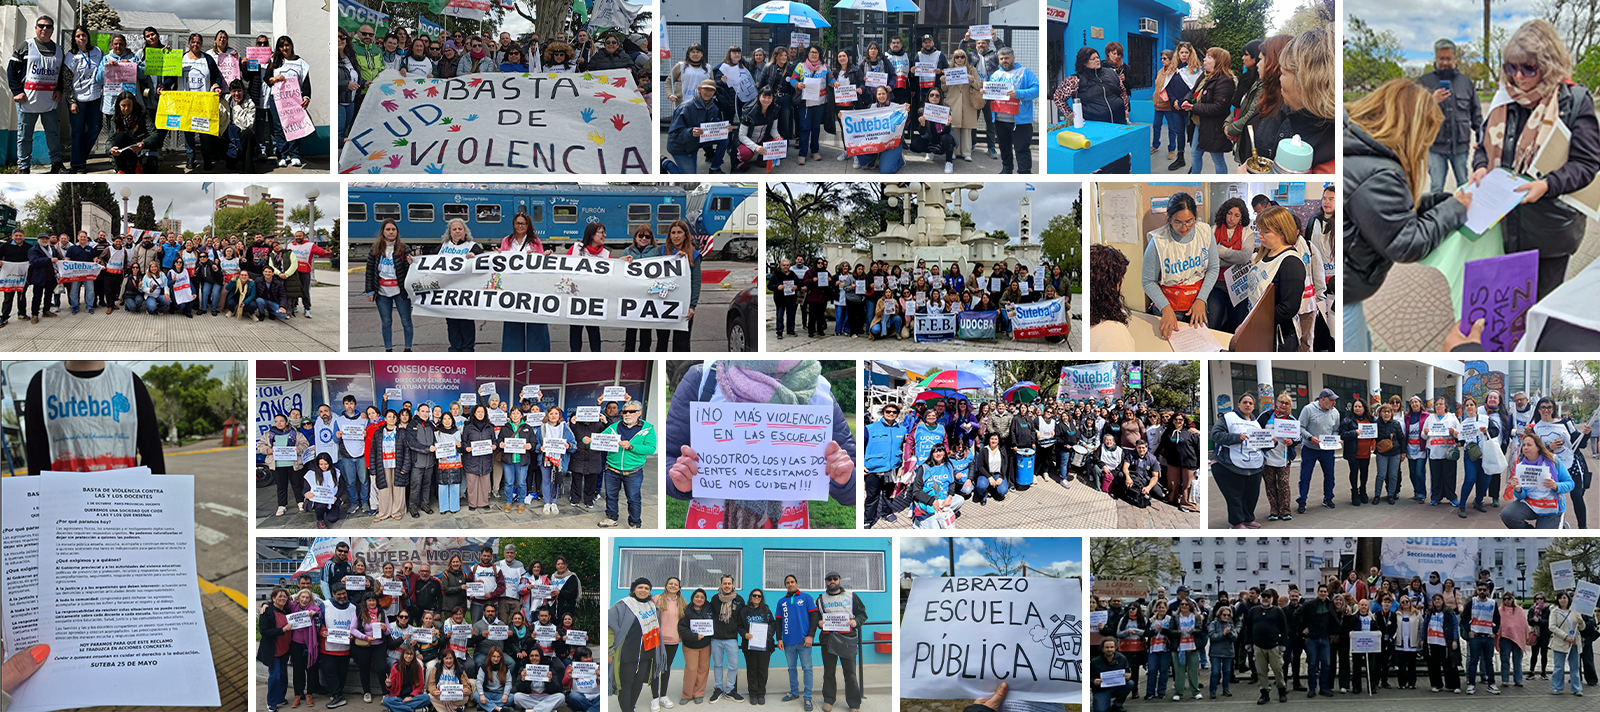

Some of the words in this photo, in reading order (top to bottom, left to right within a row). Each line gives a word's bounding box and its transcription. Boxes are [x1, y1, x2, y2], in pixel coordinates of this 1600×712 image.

[338, 4, 384, 27] DOCBA
[443, 77, 579, 100] BASTA
[498, 109, 546, 127] DE
[845, 117, 889, 134] Suteba
[410, 137, 649, 174] VIOLENCIA
[62, 262, 91, 270] Suteba
[417, 256, 464, 273] LAS
[474, 254, 610, 275] ESCUELAS
[628, 260, 682, 279] SON
[1164, 254, 1201, 275] Suteba
[416, 290, 560, 313] TERRITORIO
[571, 298, 604, 316] DE
[620, 300, 680, 320] PAZ
[1016, 306, 1050, 320] Suteba
[918, 318, 954, 331] F.E.B.
[960, 318, 994, 329] UDOCBA
[387, 365, 427, 374] CONSEJO
[430, 366, 467, 374] ESCOLAR
[1072, 370, 1110, 383] Suteba
[47, 394, 111, 420] Suteba
[256, 393, 302, 422] ANCA
[696, 408, 722, 422] ¡NO
[734, 407, 762, 422] MÁS
[767, 412, 832, 424] VIOLENCIAS
[714, 429, 734, 440] EN
[744, 430, 765, 440] LAS
[771, 431, 826, 443] ESCUELAS!
[696, 452, 760, 466] NOSOTROS,
[762, 456, 778, 465] LOS
[780, 456, 787, 466] Y
[789, 456, 806, 465] LAS
[697, 467, 737, 476] CENTES
[745, 468, 819, 477] NECESITAMOS
[700, 479, 722, 489] QUE
[729, 480, 750, 488] NOS
[1406, 537, 1457, 546] SUTEBA
[355, 550, 420, 562] SUTEBA
[941, 578, 1029, 592] ABRAZO
[924, 599, 1046, 628] ESCUELA
[912, 633, 1038, 682] PÚBLICA
